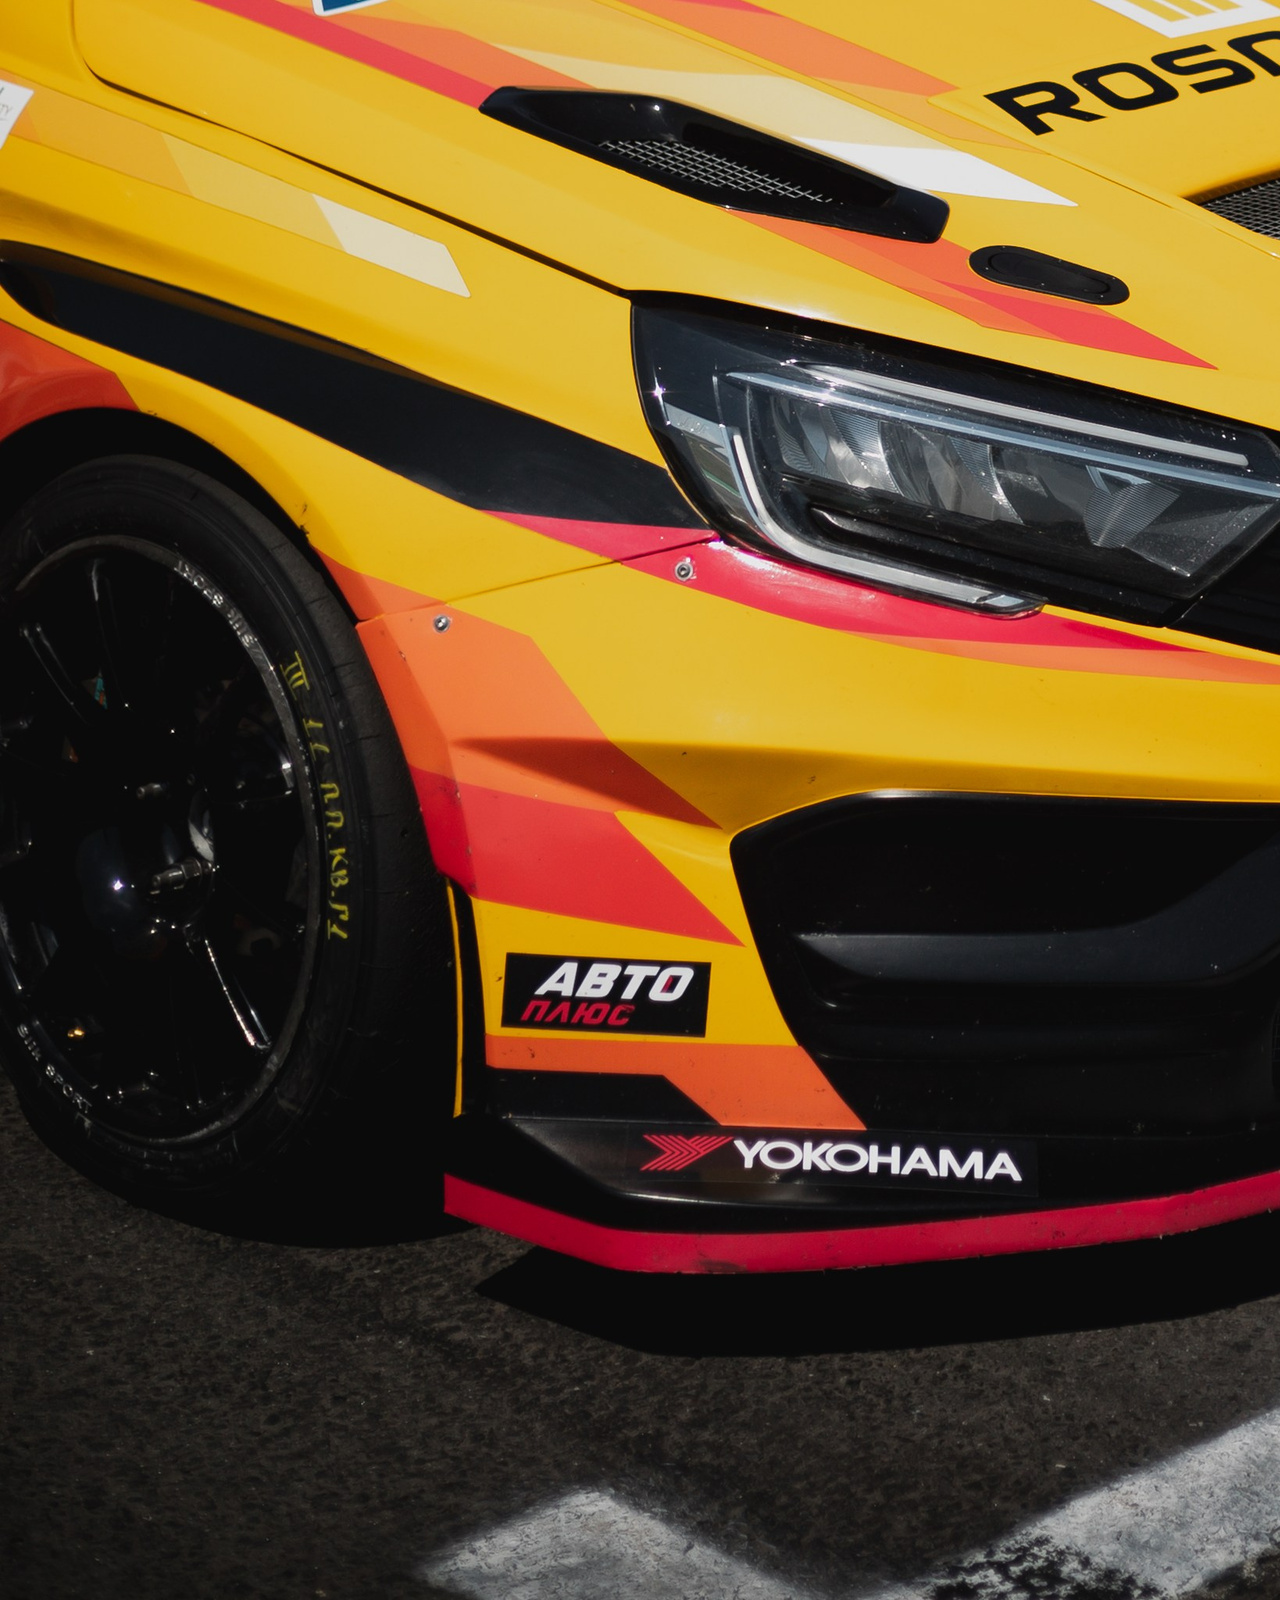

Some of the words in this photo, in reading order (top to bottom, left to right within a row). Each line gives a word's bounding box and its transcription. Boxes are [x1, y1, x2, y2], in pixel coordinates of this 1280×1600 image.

[533, 961, 695, 1002] АВТО
[519, 999, 636, 1027] ПЛЮС
[733, 1138, 1022, 1183] YOKOHAMA
